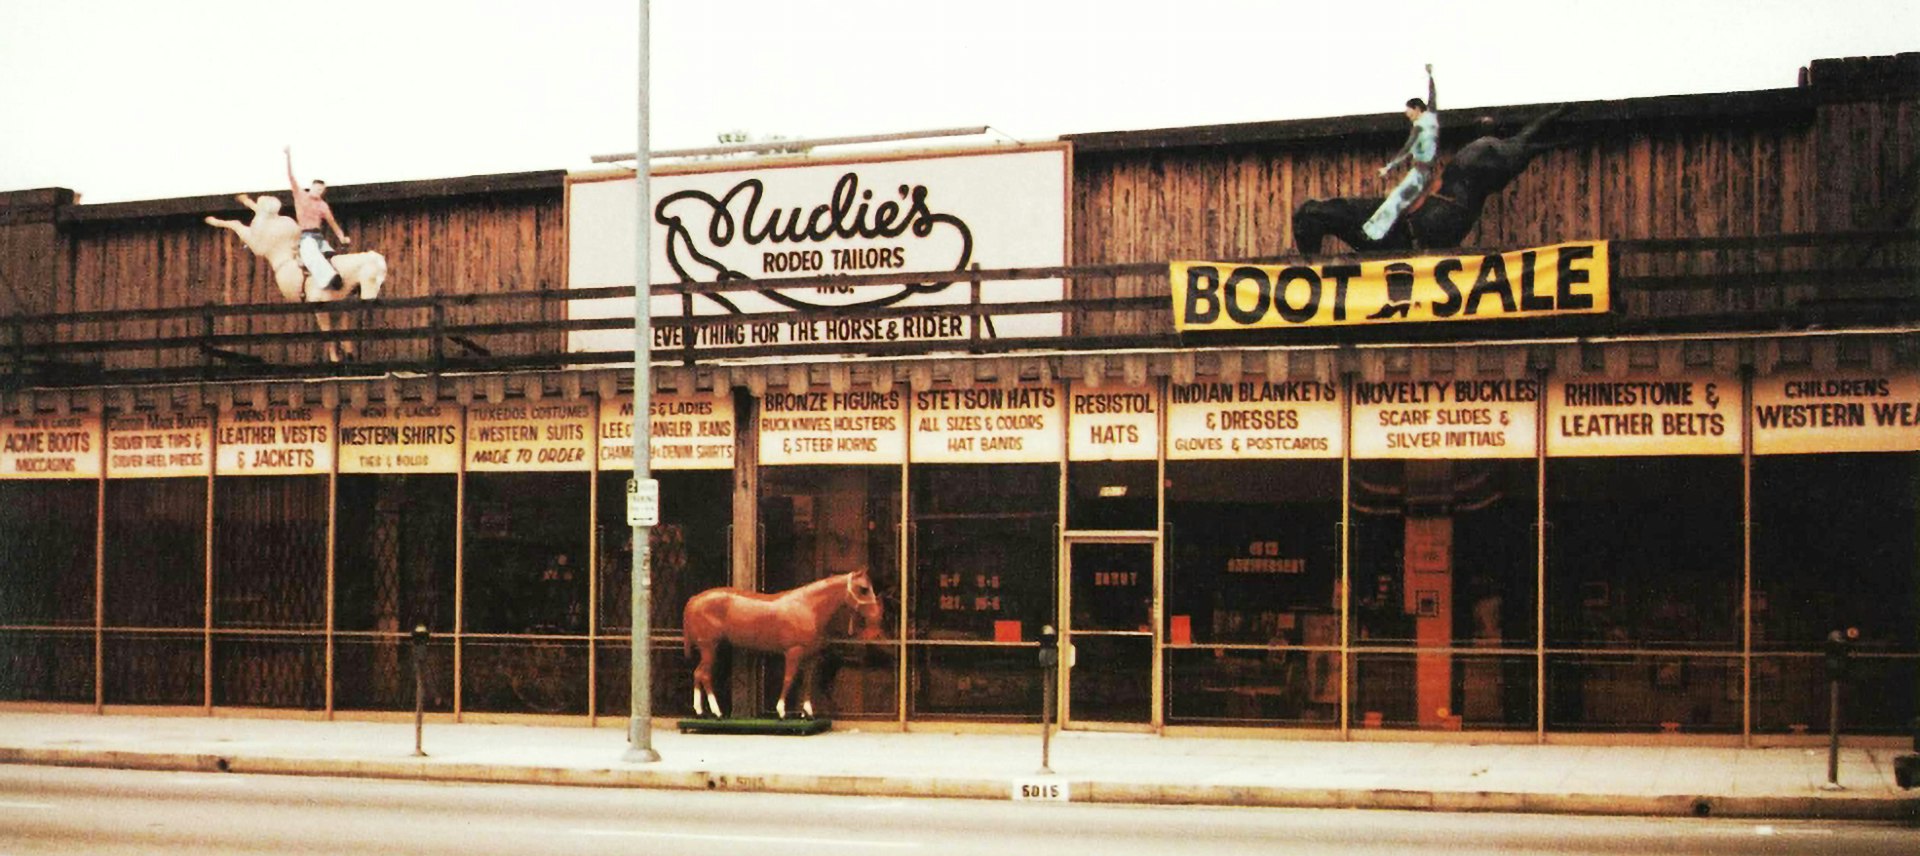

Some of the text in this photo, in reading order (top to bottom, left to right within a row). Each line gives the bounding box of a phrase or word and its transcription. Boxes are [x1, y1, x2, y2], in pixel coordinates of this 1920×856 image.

[709, 172, 932, 247] Nudie's
[763, 247, 905, 273] RODEO TAILORS
[1184, 245, 1594, 326] BOOT SALE
[654, 315, 963, 347] EVEYTHING FOR THE HORSE & RIDER
[1172, 381, 1336, 403] INDIAN BLANKETS
[1355, 379, 1537, 404] NOVELTY BUCKLES
[1565, 382, 1720, 409] RHINESTONE &
[1784, 379, 1890, 398] CHILDRENS
[619, 402, 656, 416] MS
[669, 402, 713, 415] LADIES
[765, 391, 899, 412] BRONZE FIGURES
[917, 388, 1056, 411] STETSON HATS
[1074, 395, 1155, 414] RESISTOL
[761, 418, 790, 432] BUCK
[834, 416, 897, 431] HOLSTERS
[918, 415, 1044, 432] ALL SIZES & COLORS
[1206, 410, 1299, 430] & DRESSES
[1379, 409, 1510, 426] SCARF SLIDES &
[1561, 413, 1725, 437] LEATHER BELTS
[1756, 401, 1865, 429] WESTERN
[217, 425, 327, 445] LEATHER VESTS
[341, 424, 456, 446] WESTERN SHIRTS
[479, 426, 538, 442] WESTERN
[546, 424, 584, 440] SUITS
[602, 422, 623, 438] LEE
[697, 421, 731, 437] JEANS
[1091, 425, 1139, 443] HATS
[1386, 431, 1506, 448] SILVER INITIALS
[3, 431, 90, 453] ACME BOOTS
[783, 437, 877, 454] & STEER HORNS
[948, 436, 1023, 452] HAT BANDS
[1175, 436, 1329, 453] GLOVES & POSTCARDS
[252, 448, 315, 468] JACKETS
[472, 447, 585, 464] MADE TO ORDER
[1021, 785, 1060, 798] 5015
